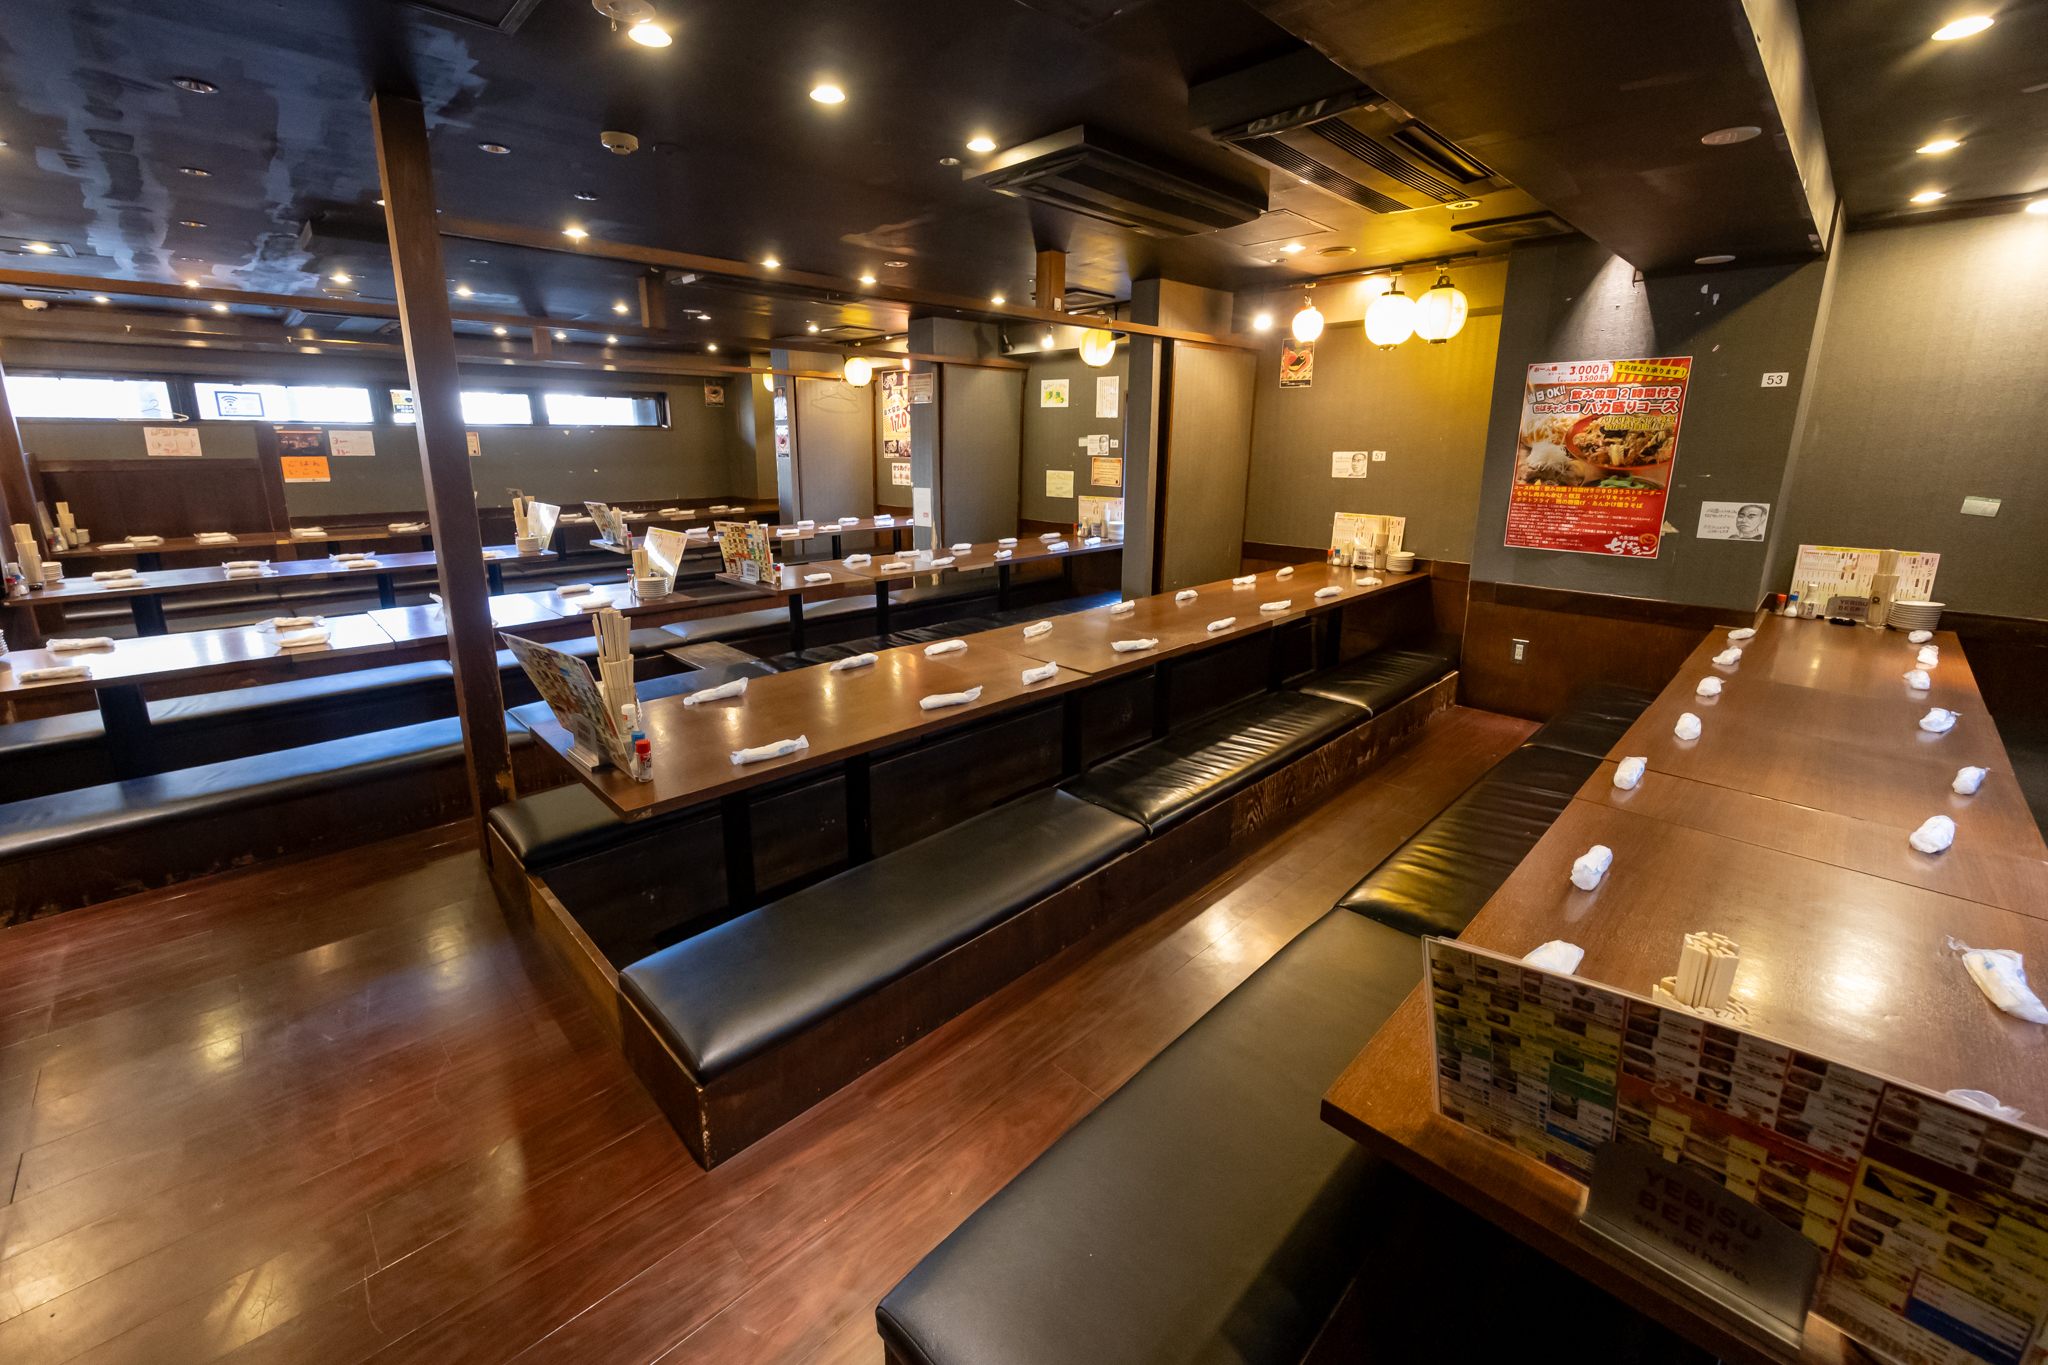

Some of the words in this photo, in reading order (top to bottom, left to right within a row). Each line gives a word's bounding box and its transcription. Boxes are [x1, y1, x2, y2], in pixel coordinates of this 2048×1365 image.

[1766, 374, 1784, 386] 53
[1583, 400, 1680, 414] バカ盛りコース
[1840, 599, 1868, 607] YEBISU
[1645, 1167, 1763, 1241] YEBISU
[1638, 1189, 1731, 1252] BEER
